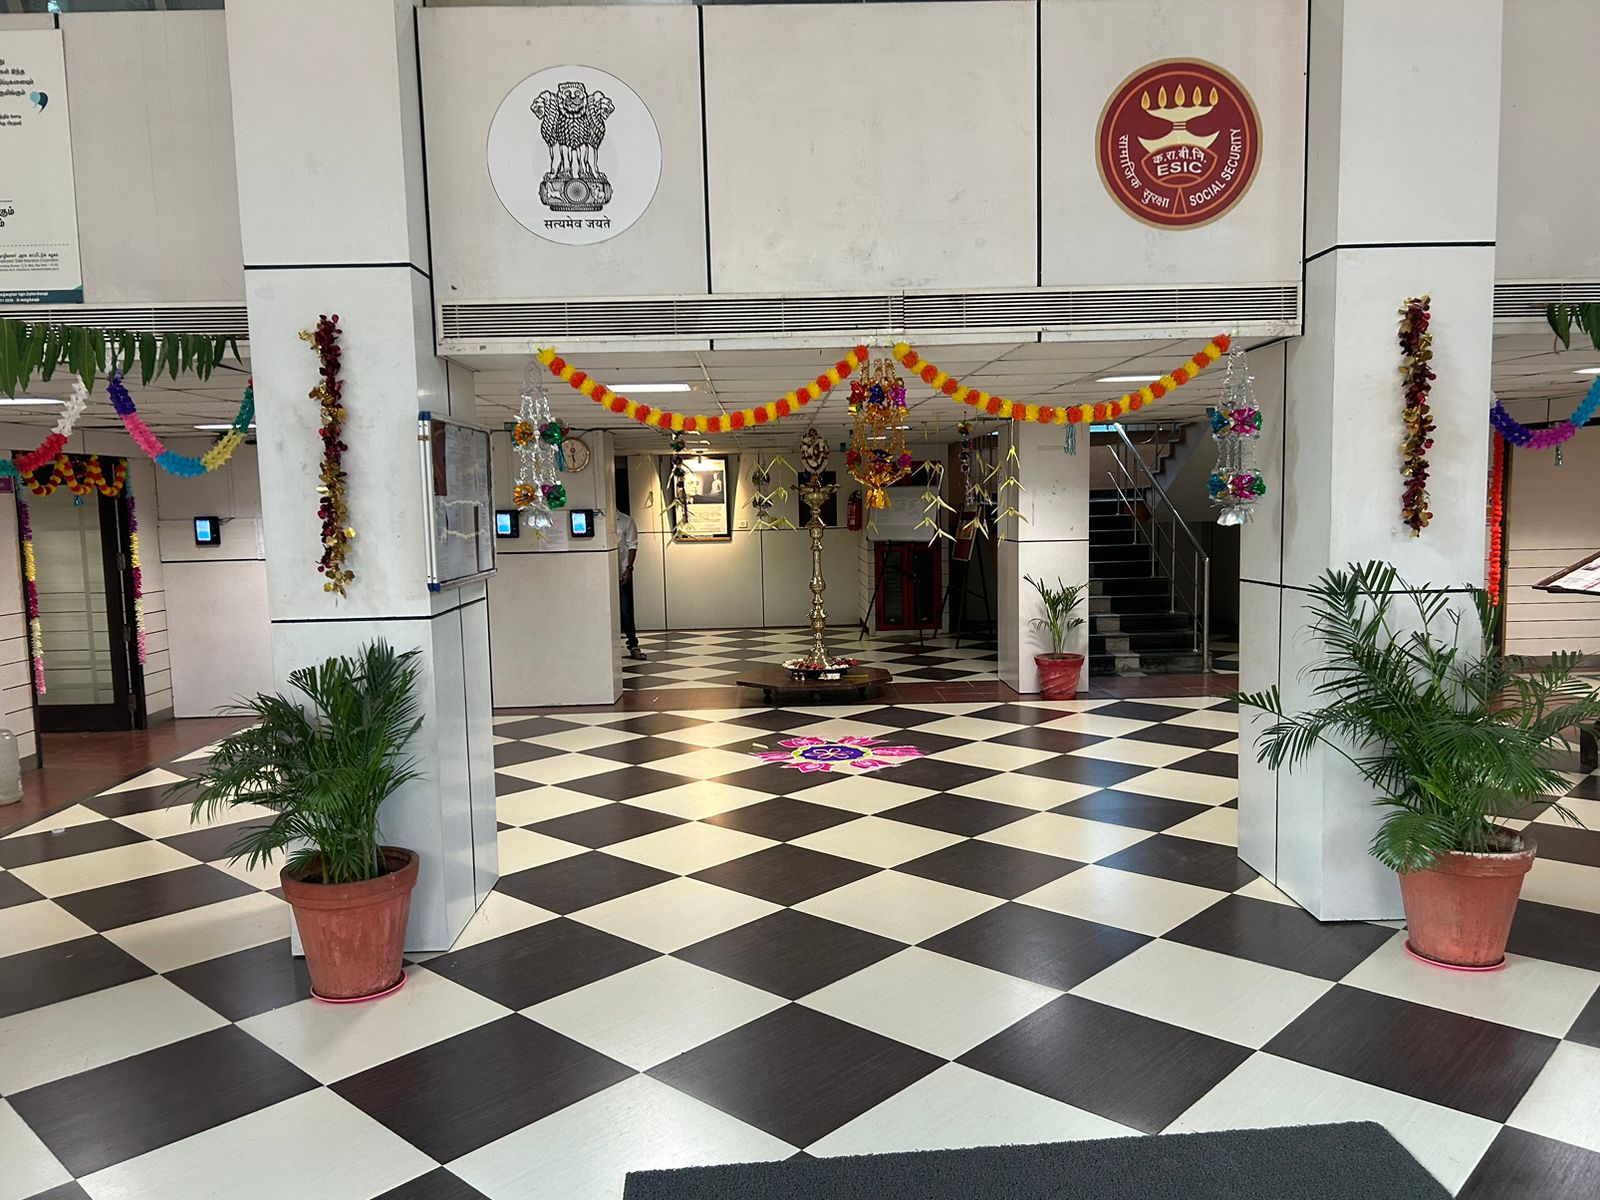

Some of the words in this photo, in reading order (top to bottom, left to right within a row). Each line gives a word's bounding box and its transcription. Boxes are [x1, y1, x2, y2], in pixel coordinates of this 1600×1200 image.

[1118, 133, 1143, 189] सामाजिक
[1141, 187, 1171, 209] सुरक्षा
[1157, 160, 1203, 177] ESIC
[1188, 180, 1226, 207] SOCIAL
[1220, 128, 1243, 181] SECURITY
[0, 206, 15, 218] கும்
[543, 215, 583, 230] सत्यमेव
[585, 215, 612, 229] जयते
